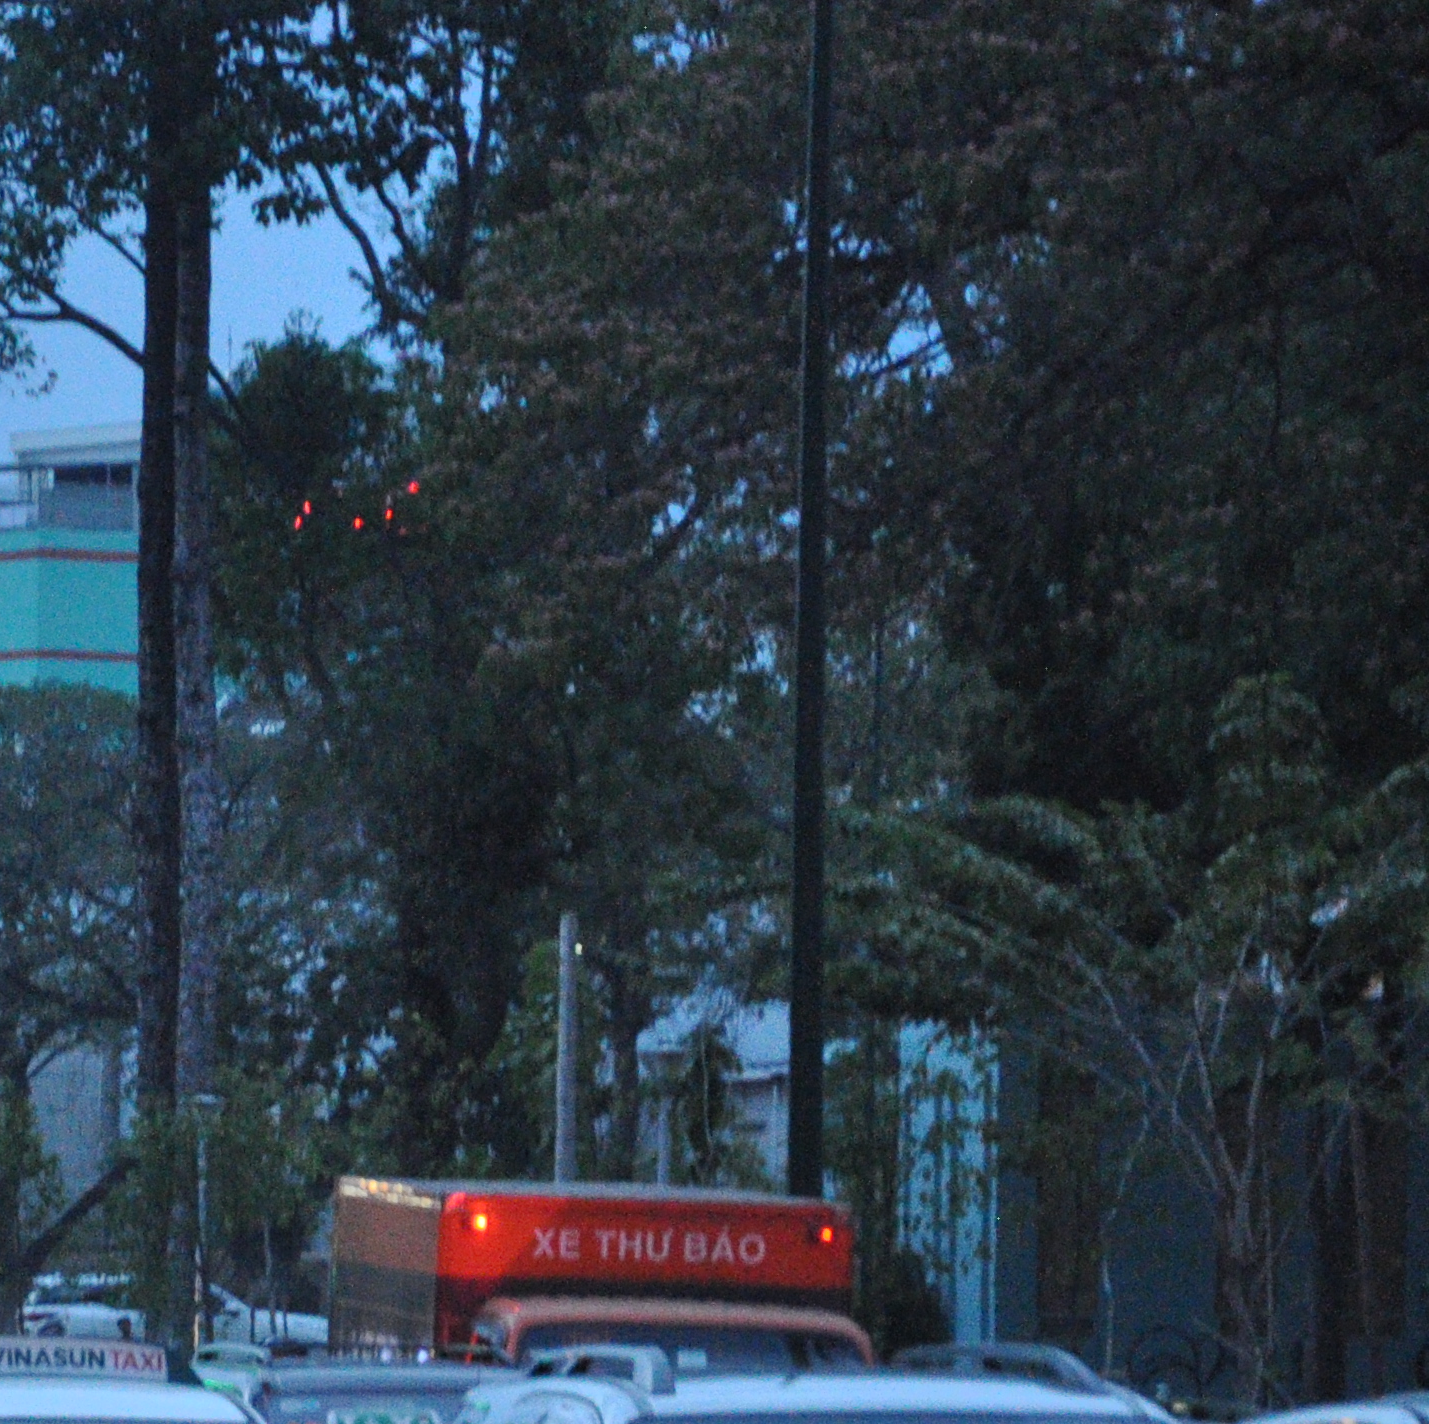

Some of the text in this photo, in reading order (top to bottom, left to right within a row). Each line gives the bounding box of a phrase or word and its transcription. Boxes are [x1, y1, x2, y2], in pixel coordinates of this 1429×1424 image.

[533, 1225, 766, 1265] XE THƯ BÁO
[112, 1350, 164, 1371] TAXI
